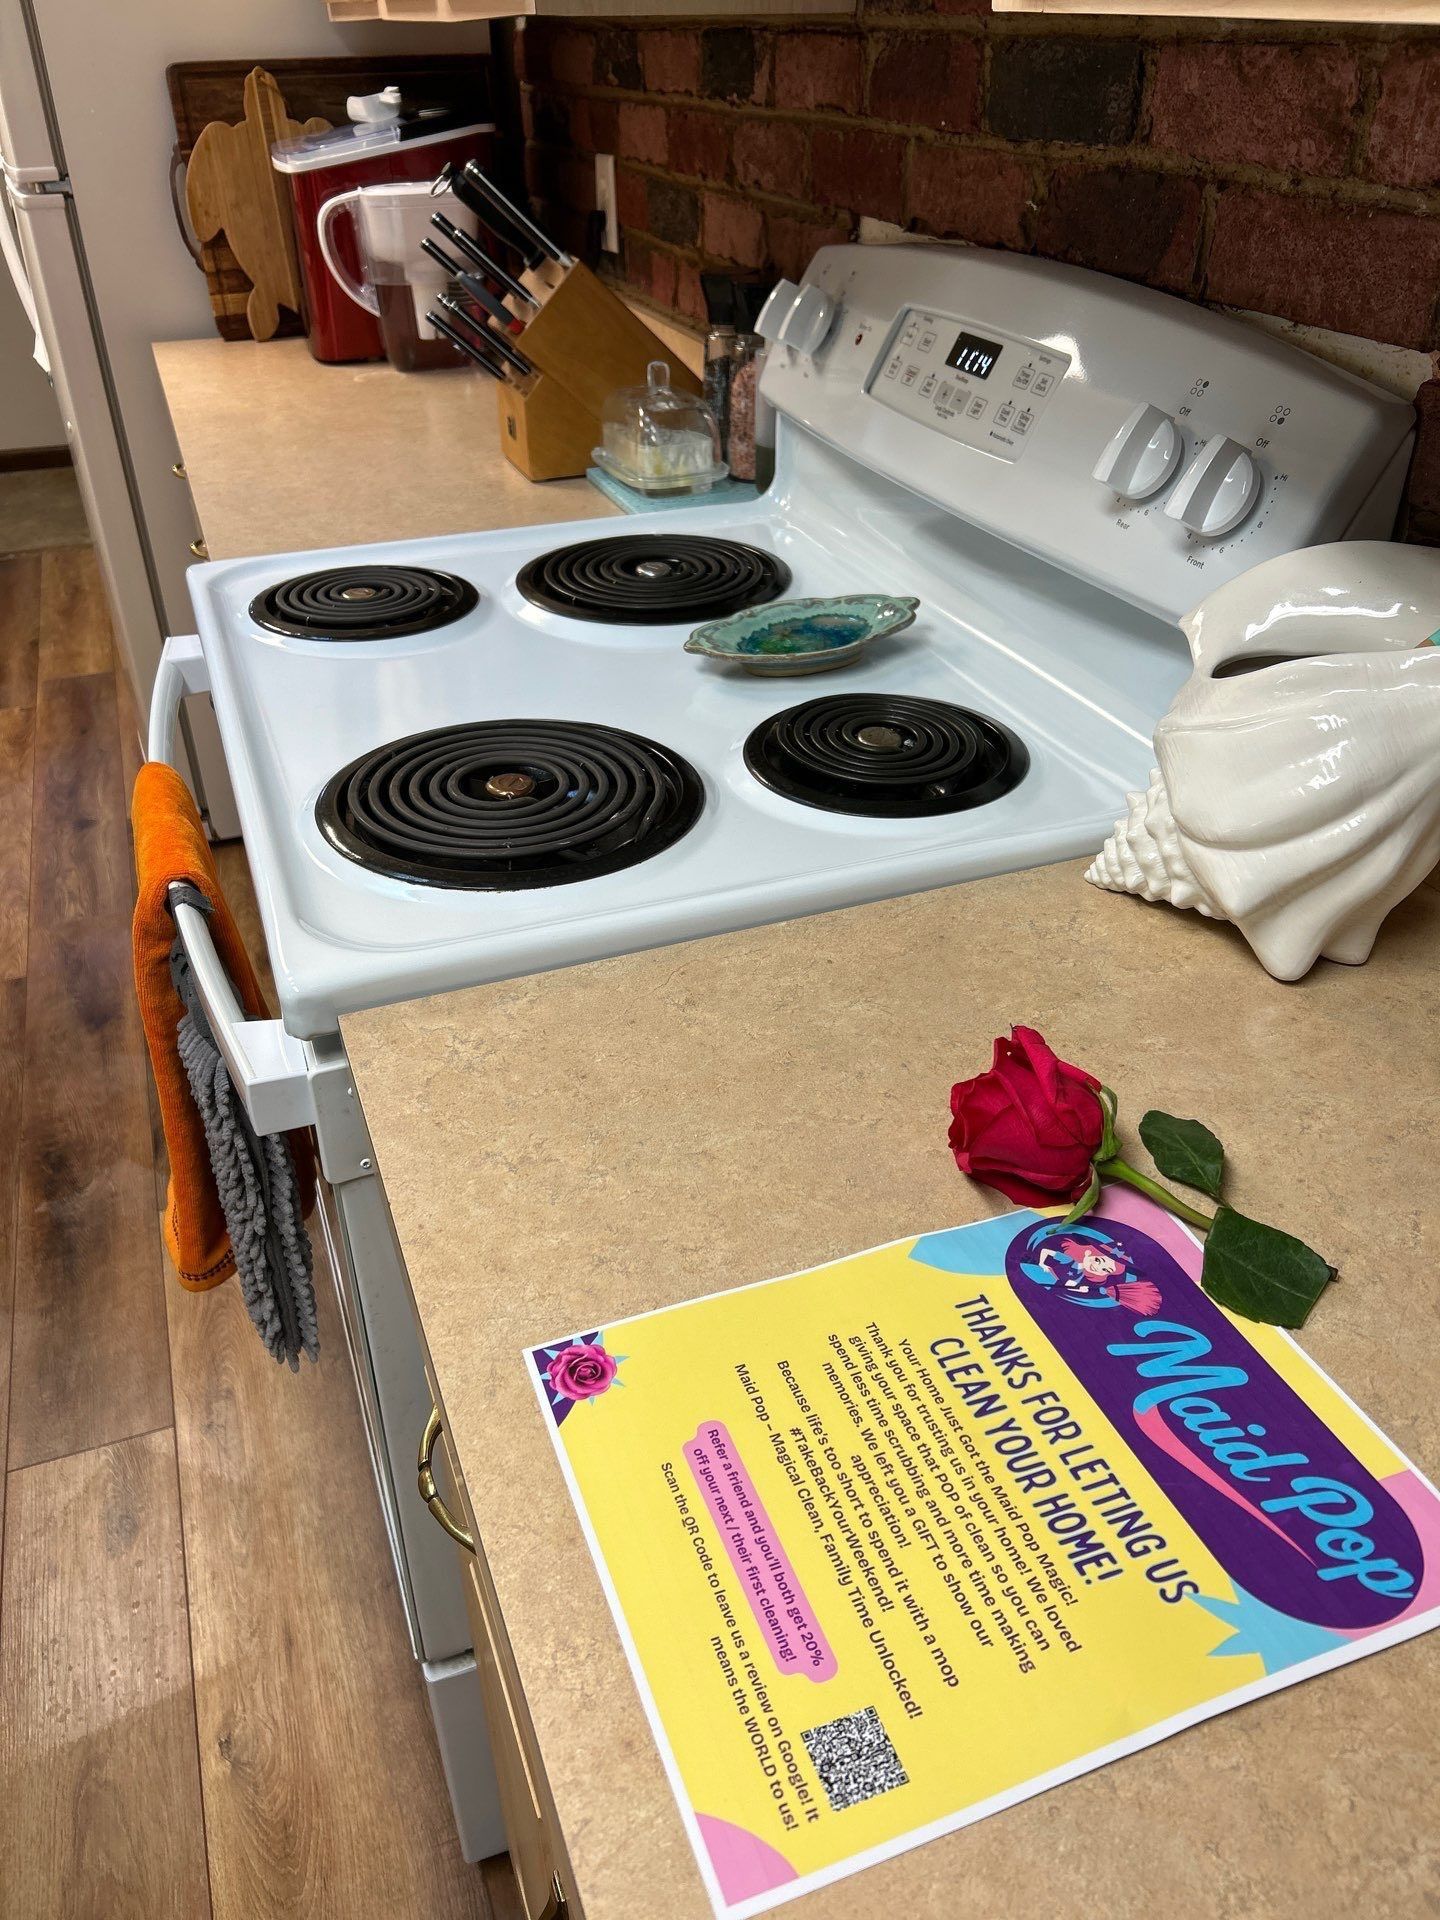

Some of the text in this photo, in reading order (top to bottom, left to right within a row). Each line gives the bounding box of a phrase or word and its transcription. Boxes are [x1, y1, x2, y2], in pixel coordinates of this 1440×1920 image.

[1179, 406, 1192, 416] Off
[1255, 437, 1270, 449] Off
[1116, 519, 1130, 530] Rear
[1187, 555, 1205, 569] Front
[693, 1448, 709, 1464] off
[699, 1467, 720, 1493] your
[714, 1496, 734, 1524] next
[734, 1363, 759, 1394] Maid
[750, 1396, 769, 1421] Pop
[769, 1432, 805, 1486] Magical
[797, 1488, 823, 1533] Clean,
[819, 1533, 852, 1586] Family
[847, 1586, 873, 1628] Time
[869, 1630, 922, 1719] Unlocked!
[776, 1360, 810, 1413] Because
[823, 1446, 841, 1470] too
[836, 1472, 864, 1510] short
[858, 1511, 872, 1528] to
[867, 1530, 903, 1578] spend
[894, 1578, 908, 1592] it
[902, 1594, 928, 1631] with
[923, 1634, 935, 1645] a
[930, 1648, 958, 1687] mop
[789, 1427, 894, 1612] #TakeBackYourWeekend!
[821, 1362, 993, 1646] memories. We left you a GIFT to show our
[827, 1334, 1035, 1673] spend less time scrubbing and more time making
[848, 1336, 1049, 1651] giving your space that POP of clean so you can
[850, 1454, 911, 1548] appreciation!
[865, 1321, 1082, 1652] Thank you for trusting us in your home! We loved
[898, 1338, 1078, 1606] Your Home Just Got the Maid Pop Magic!
[929, 1337, 1123, 1585] CLEAN YOUR HOME!
[954, 1294, 1199, 1603] THANKS FOR LETTING US
[1106, 1320, 1415, 1599] Maid Pop
[661, 1462, 818, 1822] Scan the QR Code to leave us a review on Google! It
[707, 1429, 728, 1459] Refer
[726, 1471, 752, 1508] friend
[744, 1510, 764, 1534] and
[773, 1571, 794, 1605] both
[786, 1607, 806, 1630] get
[800, 1632, 823, 1666] 20%
[731, 1532, 751, 1563] their
[745, 1566, 765, 1595] first
[759, 1598, 796, 1662] cleaning!
[710, 1636, 798, 1830] means the WORLD to us!
